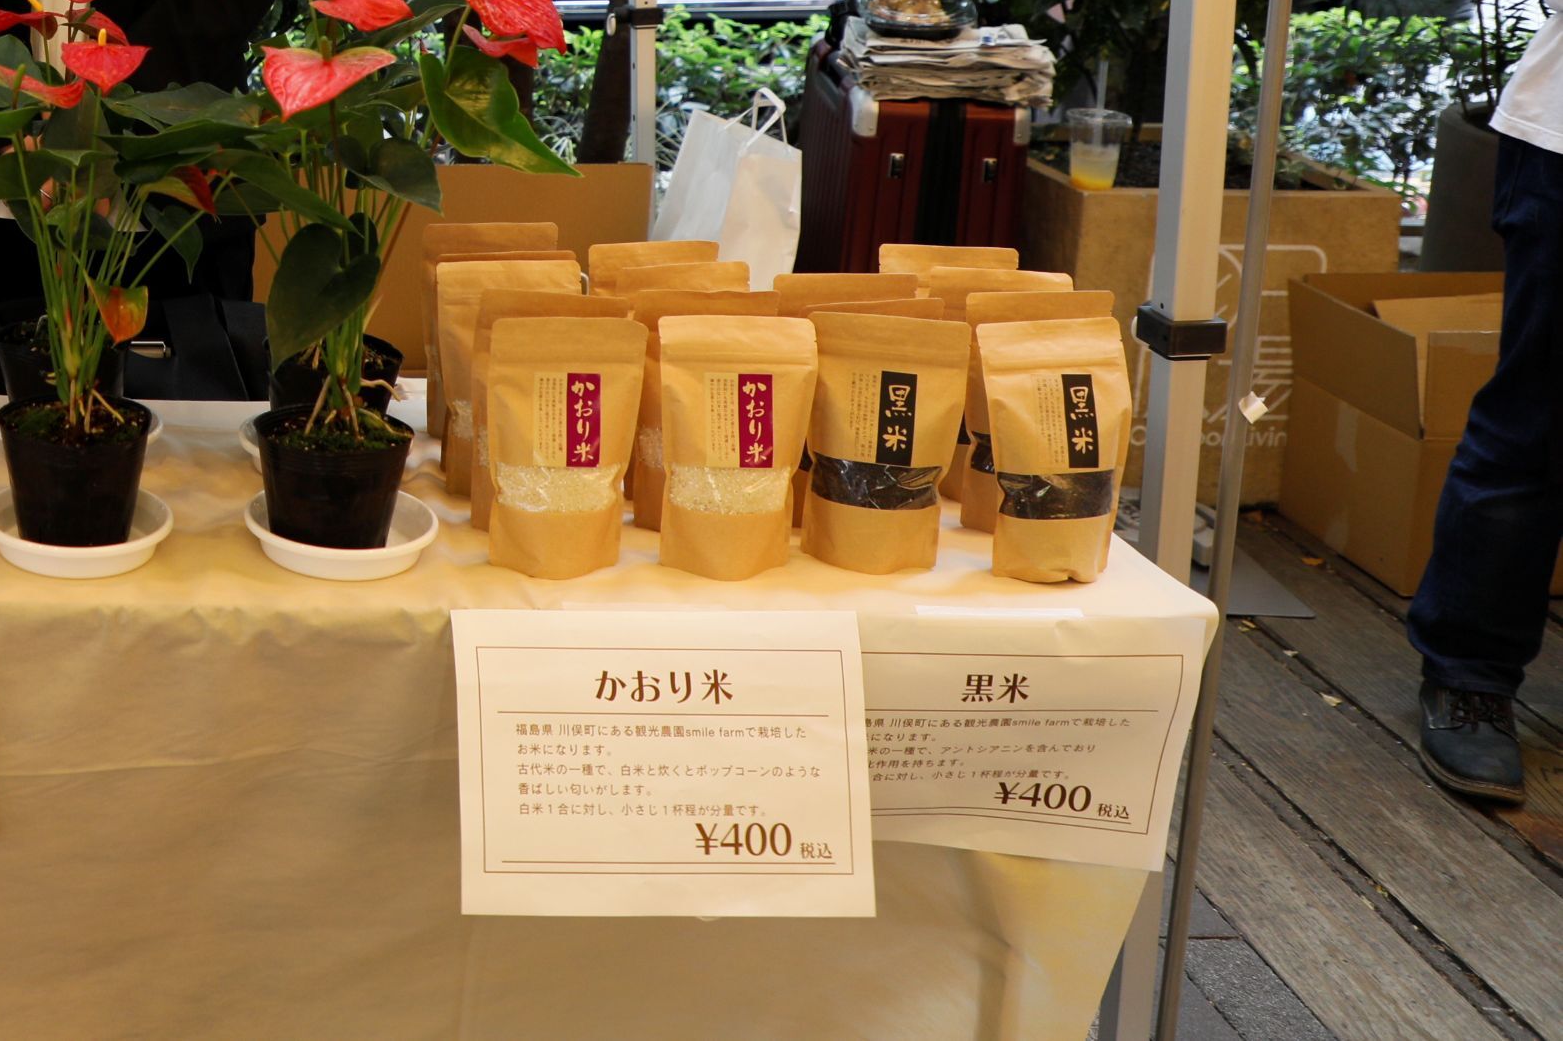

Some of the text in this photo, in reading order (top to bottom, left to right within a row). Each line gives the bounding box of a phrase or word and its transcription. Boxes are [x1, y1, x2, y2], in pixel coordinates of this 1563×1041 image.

[571, 380, 596, 463] かおり米
[742, 380, 767, 464] かおり米
[882, 384, 912, 452] 黒米
[1070, 386, 1094, 455] 黒米
[595, 669, 733, 705] かおり米
[960, 673, 1030, 704] 黒米
[515, 723, 553, 736] 福島県
[718, 726, 807, 739] farmで栽培した
[868, 731, 937, 743] になります。
[517, 743, 611, 757] お米になります。
[518, 782, 651, 797] 香ばしい匂いがします。
[994, 782, 1130, 820] ¥400 税込
[695, 822, 833, 860] ¥400 税込
